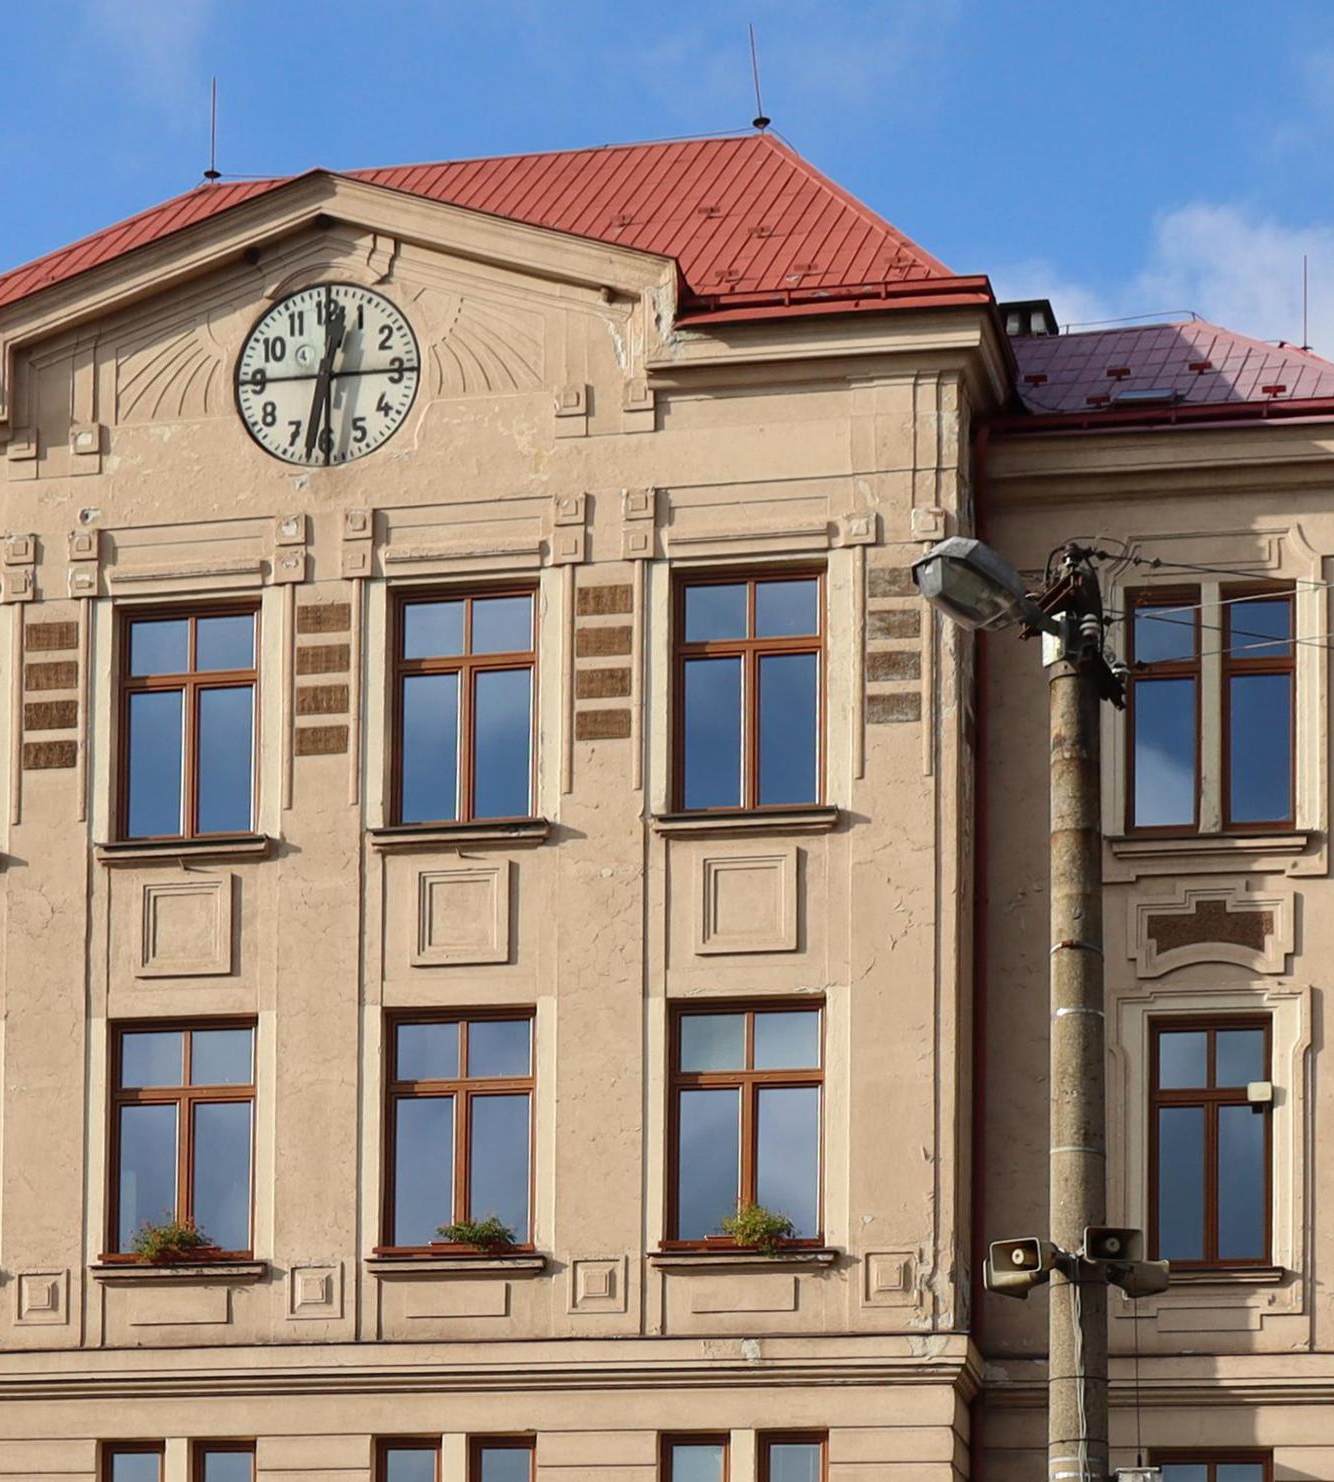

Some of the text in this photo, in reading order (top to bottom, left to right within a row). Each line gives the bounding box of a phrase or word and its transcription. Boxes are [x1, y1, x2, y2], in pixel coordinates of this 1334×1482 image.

[288, 310, 305, 337] 11
[357, 304, 364, 330] 1
[262, 336, 287, 363] 10
[378, 324, 394, 351] 2
[250, 367, 267, 395] 9
[388, 356, 405, 384] 3
[261, 401, 278, 428] 8
[375, 391, 394, 418] 4
[287, 420, 302, 447] 7
[317, 426, 334, 454] 6
[351, 417, 368, 443] 5
